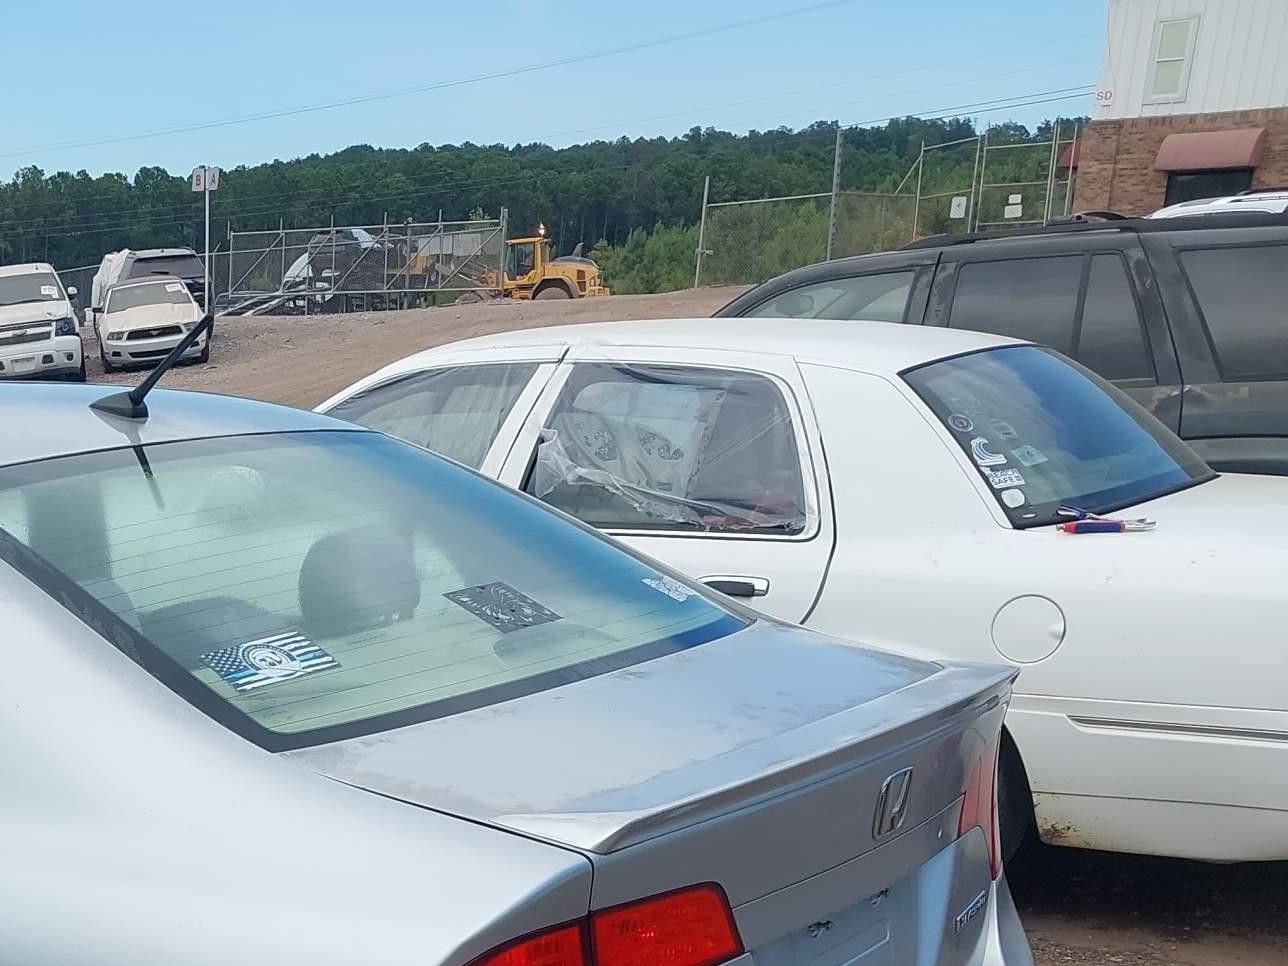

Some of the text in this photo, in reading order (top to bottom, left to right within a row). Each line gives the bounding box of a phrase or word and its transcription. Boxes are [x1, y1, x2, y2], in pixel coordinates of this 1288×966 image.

[1096, 90, 1113, 101] SD
[195, 174, 202, 187] B
[210, 173, 216, 185] A
